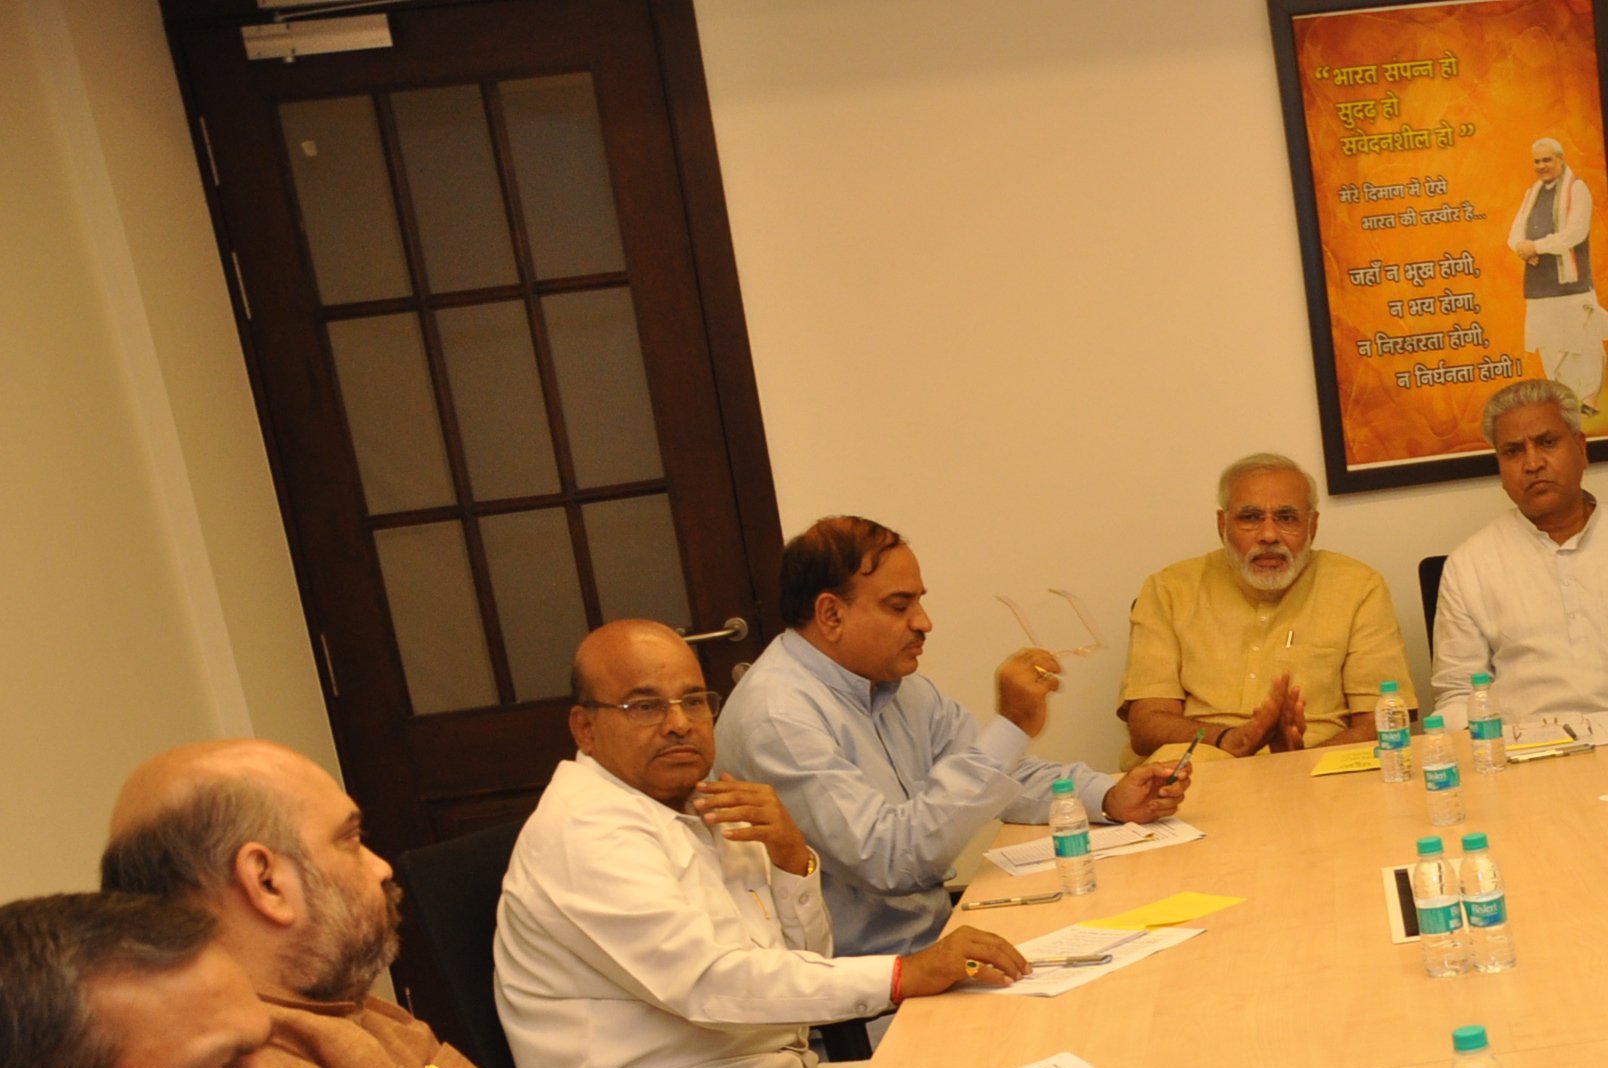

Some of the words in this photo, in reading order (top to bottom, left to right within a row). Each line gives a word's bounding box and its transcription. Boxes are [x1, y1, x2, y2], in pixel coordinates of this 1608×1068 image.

[1383, 57, 1434, 82] संपन्न
[1439, 51, 1458, 79] हो
[1381, 91, 1400, 118] हो
[1339, 185, 1360, 203] मेरे
[1363, 182, 1405, 202] दिमाग
[1408, 177, 1421, 197] में
[1425, 176, 1448, 197] ऐसे
[1362, 214, 1396, 231] भारत
[1400, 208, 1417, 227] की
[1421, 204, 1461, 224] तस्वीर
[1349, 260, 1382, 286] जहाँ
[1385, 265, 1399, 282] न
[1404, 261, 1435, 286] भूख
[1439, 251, 1480, 278] होगी,
[1389, 300, 1403, 317] न
[1409, 297, 1435, 316] भय
[1357, 340, 1371, 357] न
[1375, 331, 1444, 355] निरक्षरता
[1448, 321, 1489, 349] होगी,
[1397, 371, 1411, 388] न
[1415, 361, 1473, 387] निर्धनता
